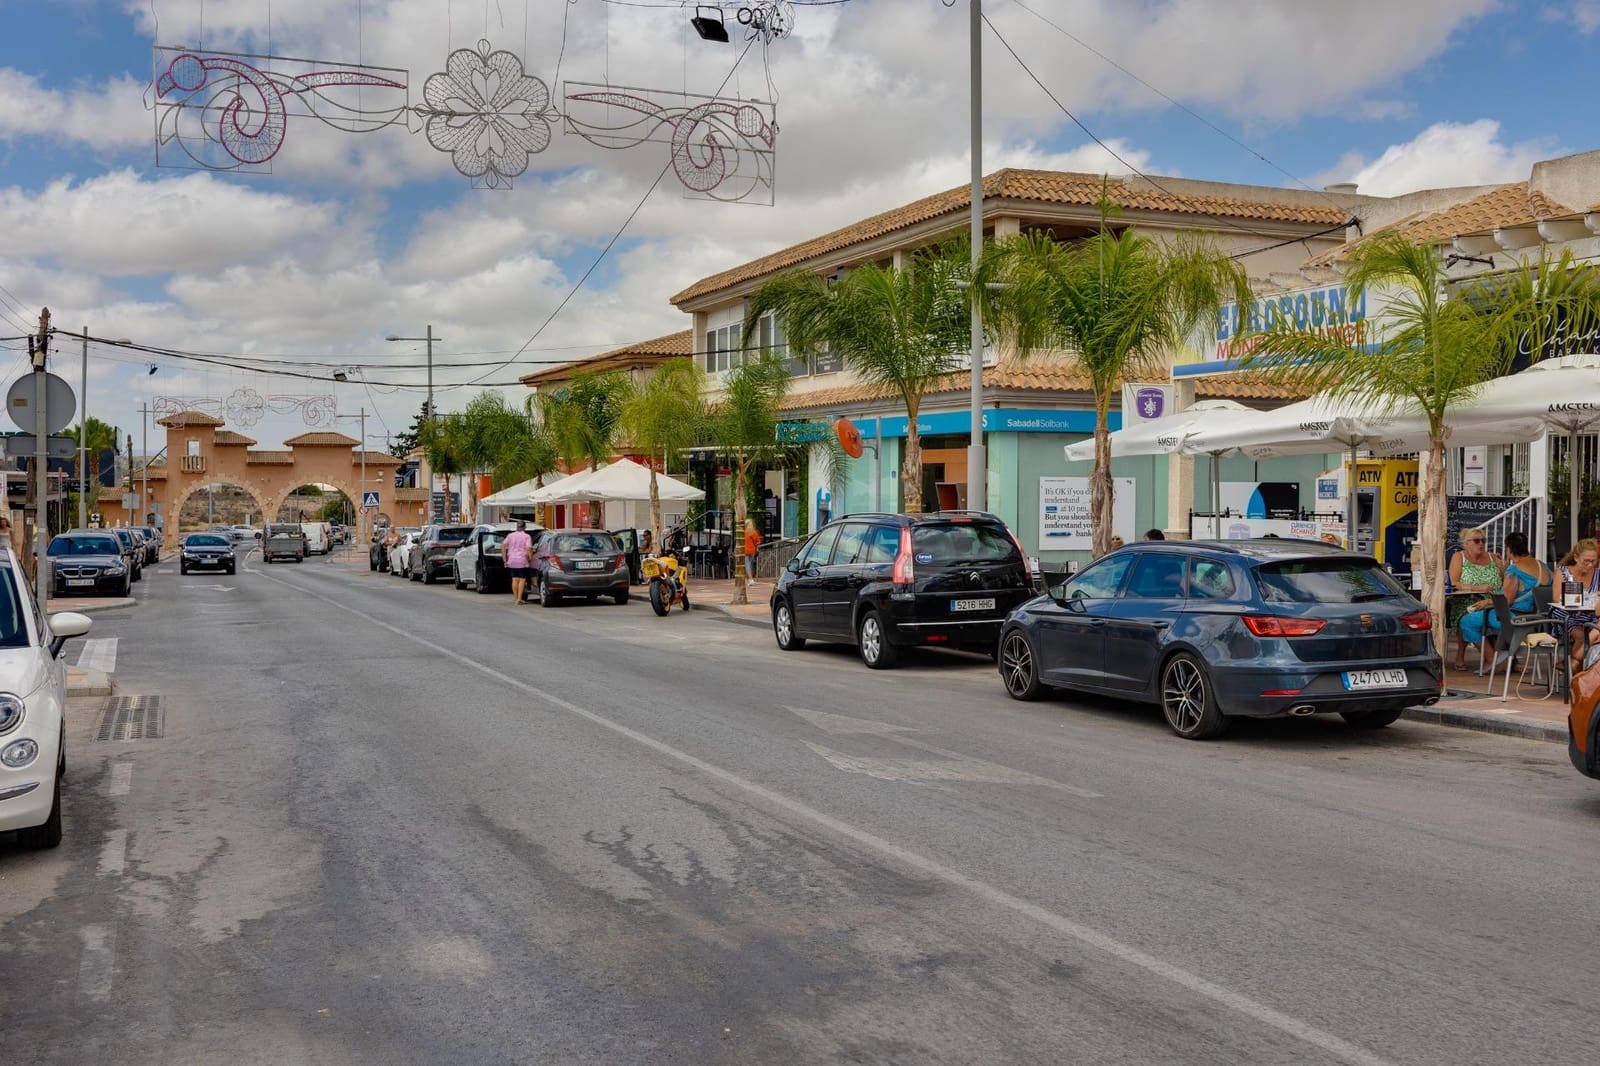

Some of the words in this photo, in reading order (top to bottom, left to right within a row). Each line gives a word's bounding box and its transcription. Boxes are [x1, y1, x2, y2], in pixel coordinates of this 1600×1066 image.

[1216, 333, 1267, 360] MONE
[1072, 490, 1084, 498] you
[1394, 491, 1419, 506] Caje
[1457, 500, 1478, 509] DAILY
[1479, 501, 1512, 511] SPECIALS
[957, 600, 976, 609] 5216
[979, 599, 993, 608] HHG
[1351, 672, 1381, 685] 2470
[1382, 671, 1404, 683] LHD
